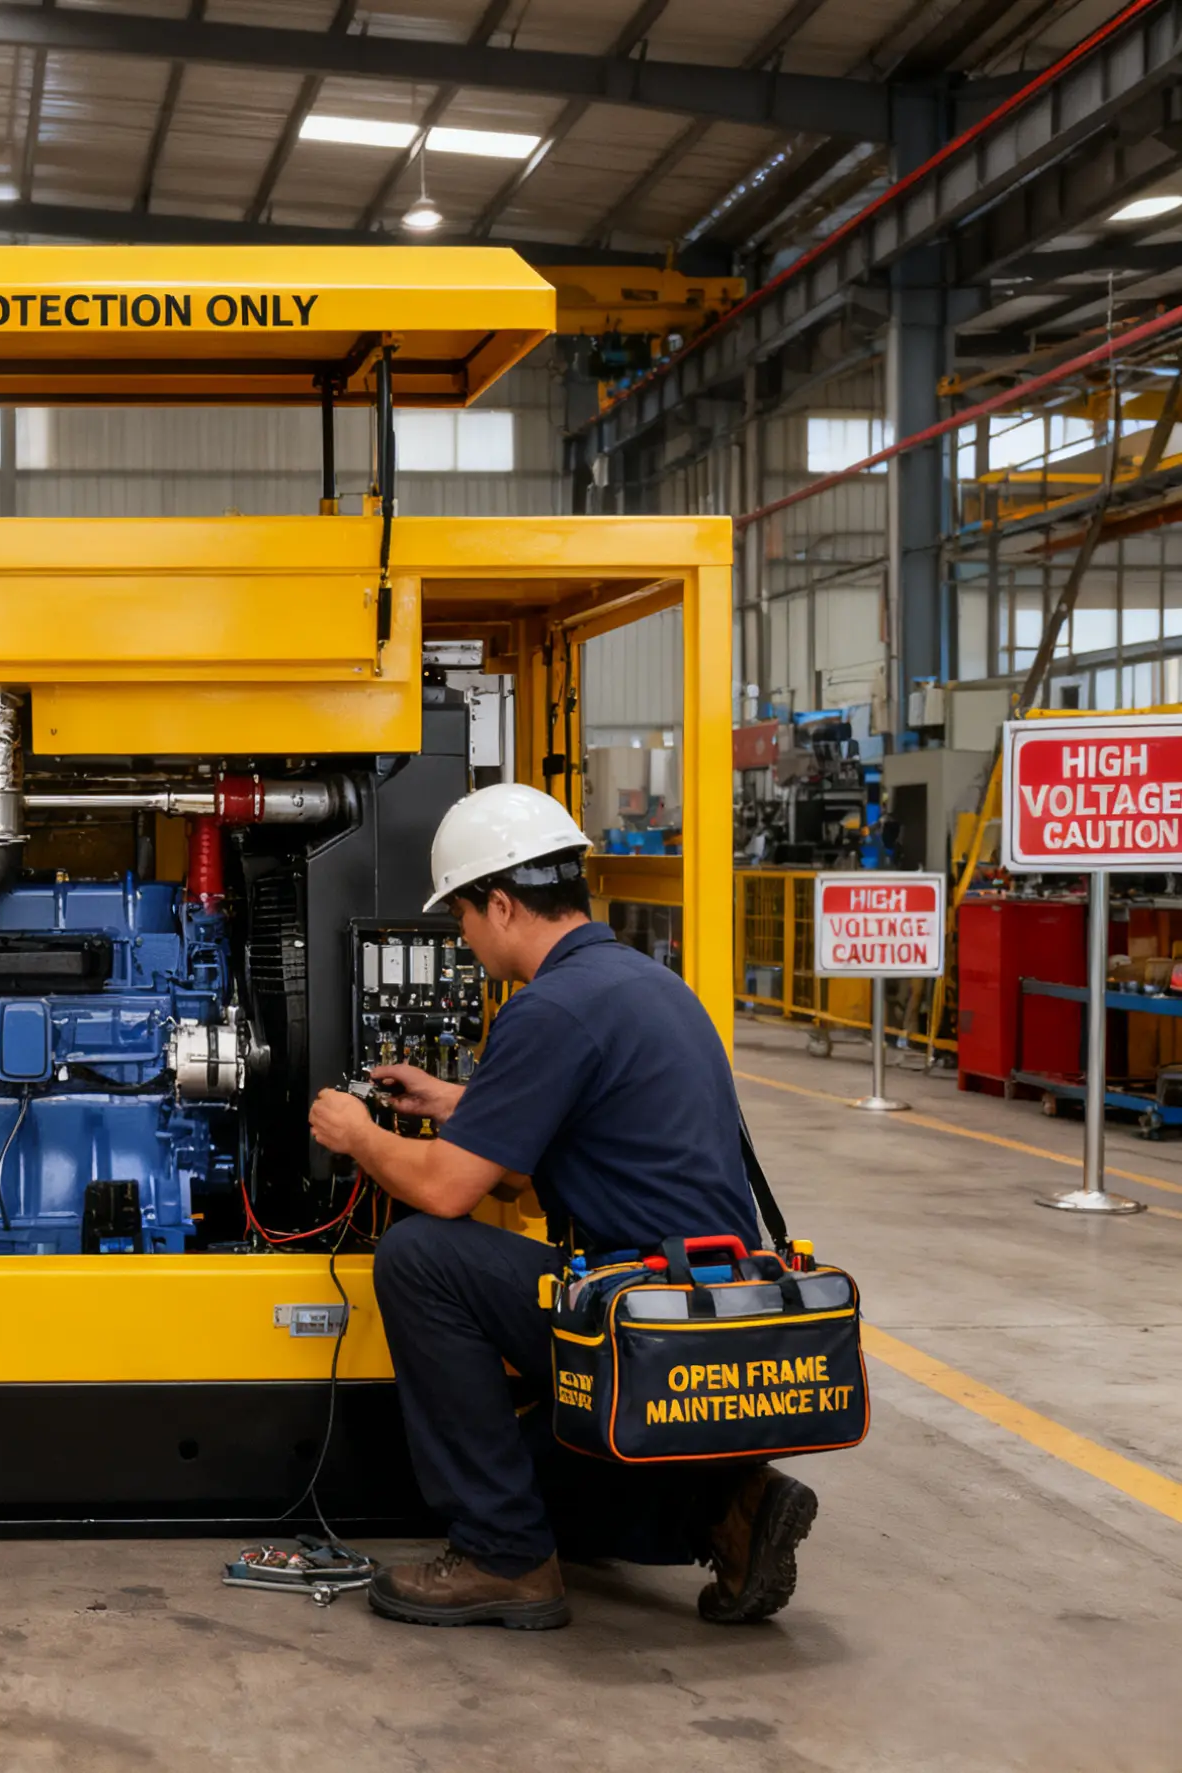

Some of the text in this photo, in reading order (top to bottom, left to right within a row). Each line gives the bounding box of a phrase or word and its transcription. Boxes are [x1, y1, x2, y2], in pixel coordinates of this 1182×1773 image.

[206, 294, 319, 327] ONLY
[1062, 744, 1148, 779] HIGH
[1020, 782, 1182, 817] VOLTAGE
[1043, 818, 1179, 849] CAUTION
[832, 943, 927, 964] CAUTION
[668, 1355, 830, 1392] OPEN FRAME
[646, 1384, 855, 1426] MAINTENANCE KIT
